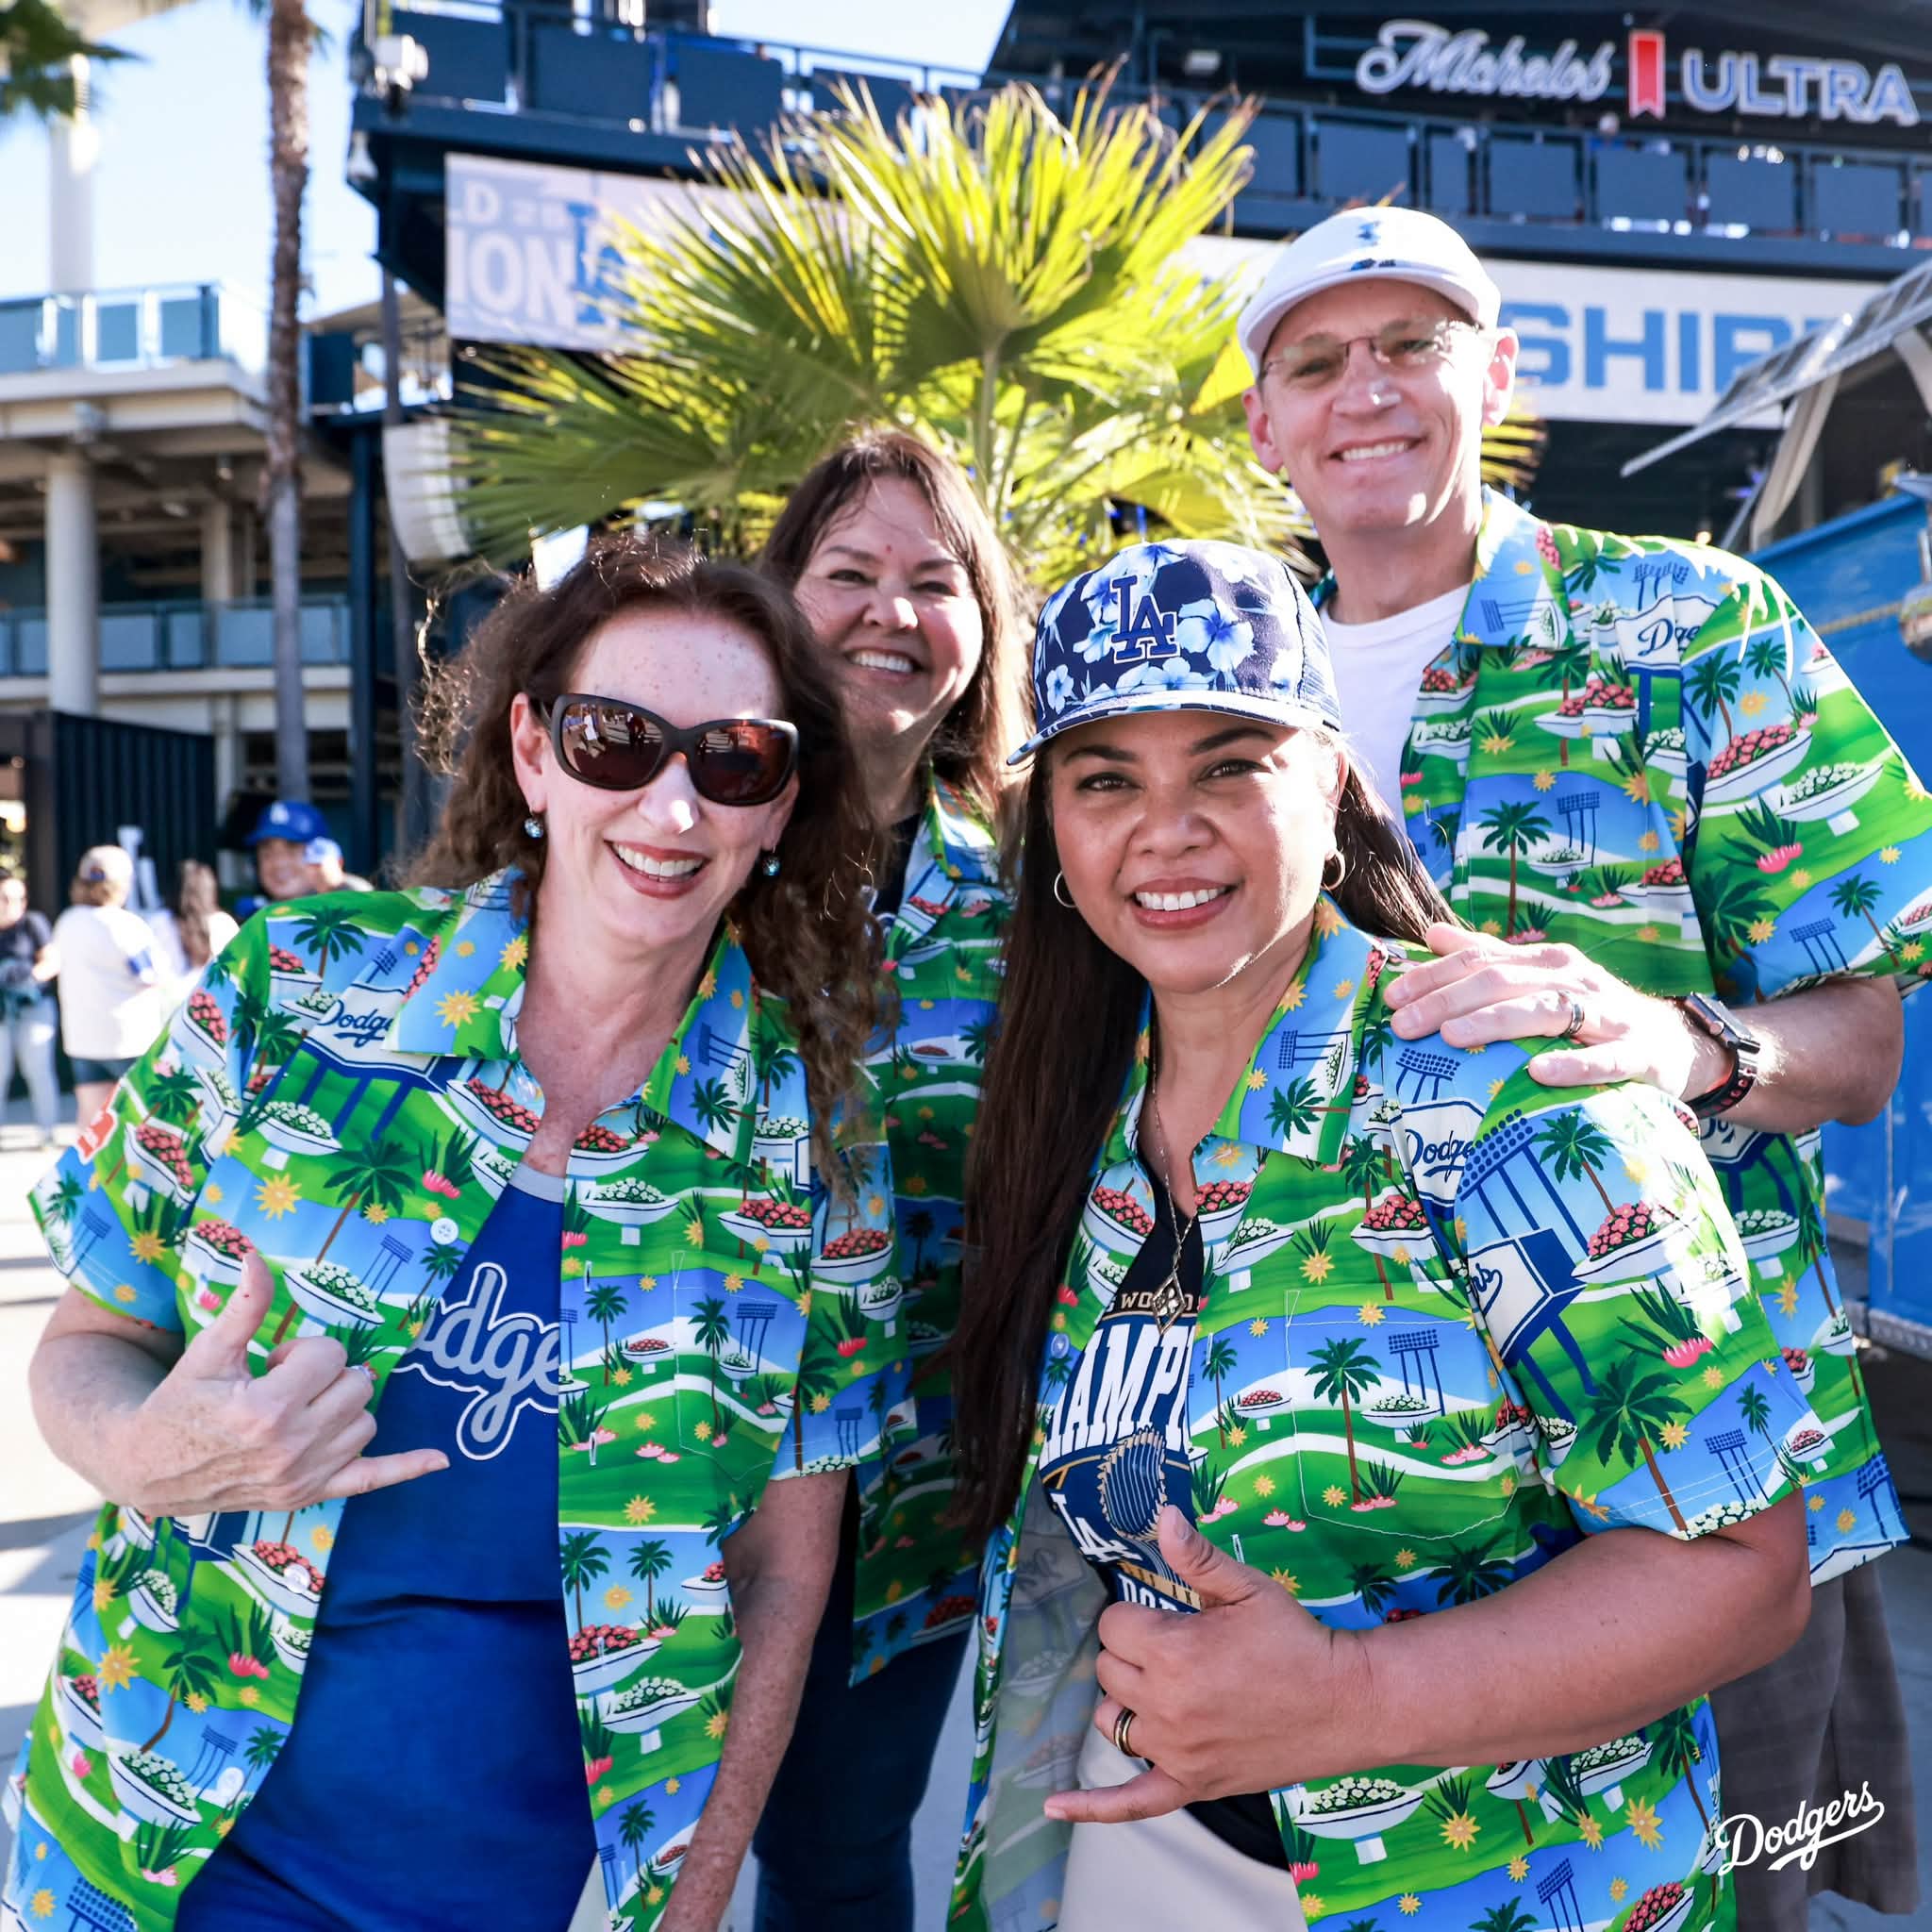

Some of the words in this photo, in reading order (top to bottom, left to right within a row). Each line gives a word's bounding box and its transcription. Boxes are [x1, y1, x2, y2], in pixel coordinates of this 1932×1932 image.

[1356, 18, 1616, 103] Michelob
[1681, 48, 1921, 126] ULTRA
[1497, 301, 1821, 393] SHIP
[1111, 574, 1180, 664] LA
[392, 1261, 560, 1461] dge
[1049, 1492, 1143, 1563] LA
